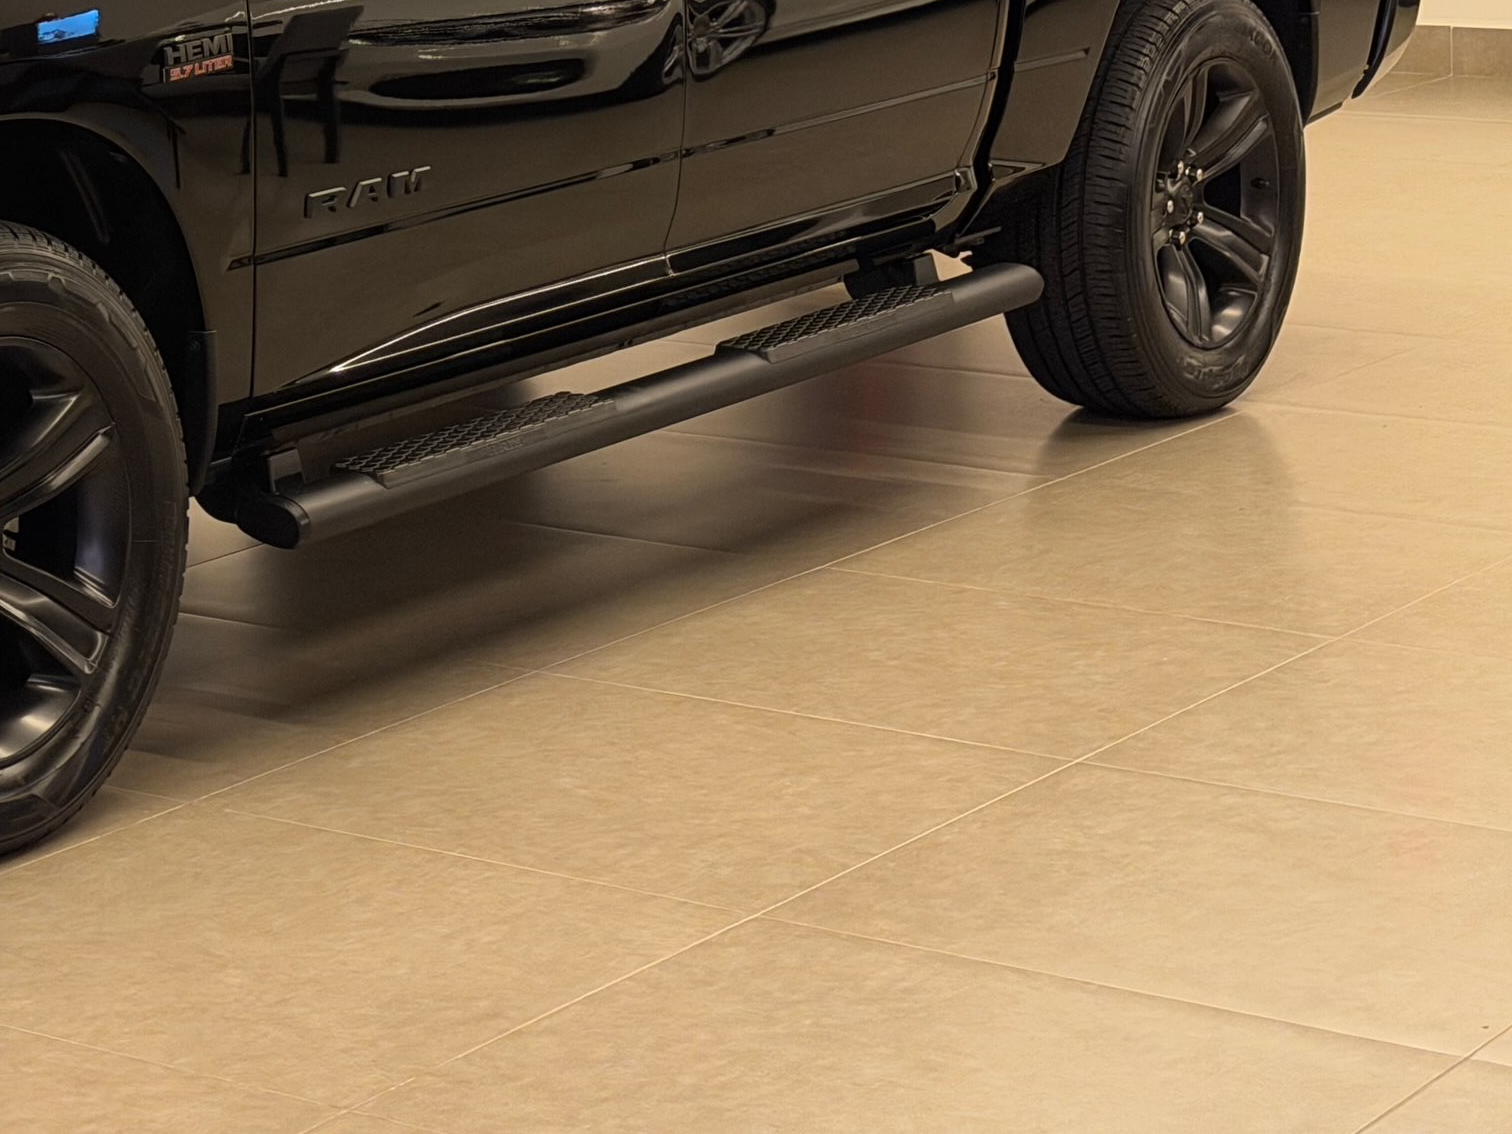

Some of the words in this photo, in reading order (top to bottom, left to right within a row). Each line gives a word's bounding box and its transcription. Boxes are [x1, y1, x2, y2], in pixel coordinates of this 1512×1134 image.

[163, 32, 233, 65] HEMI
[194, 54, 233, 75] LITER
[304, 165, 431, 219] RAM
